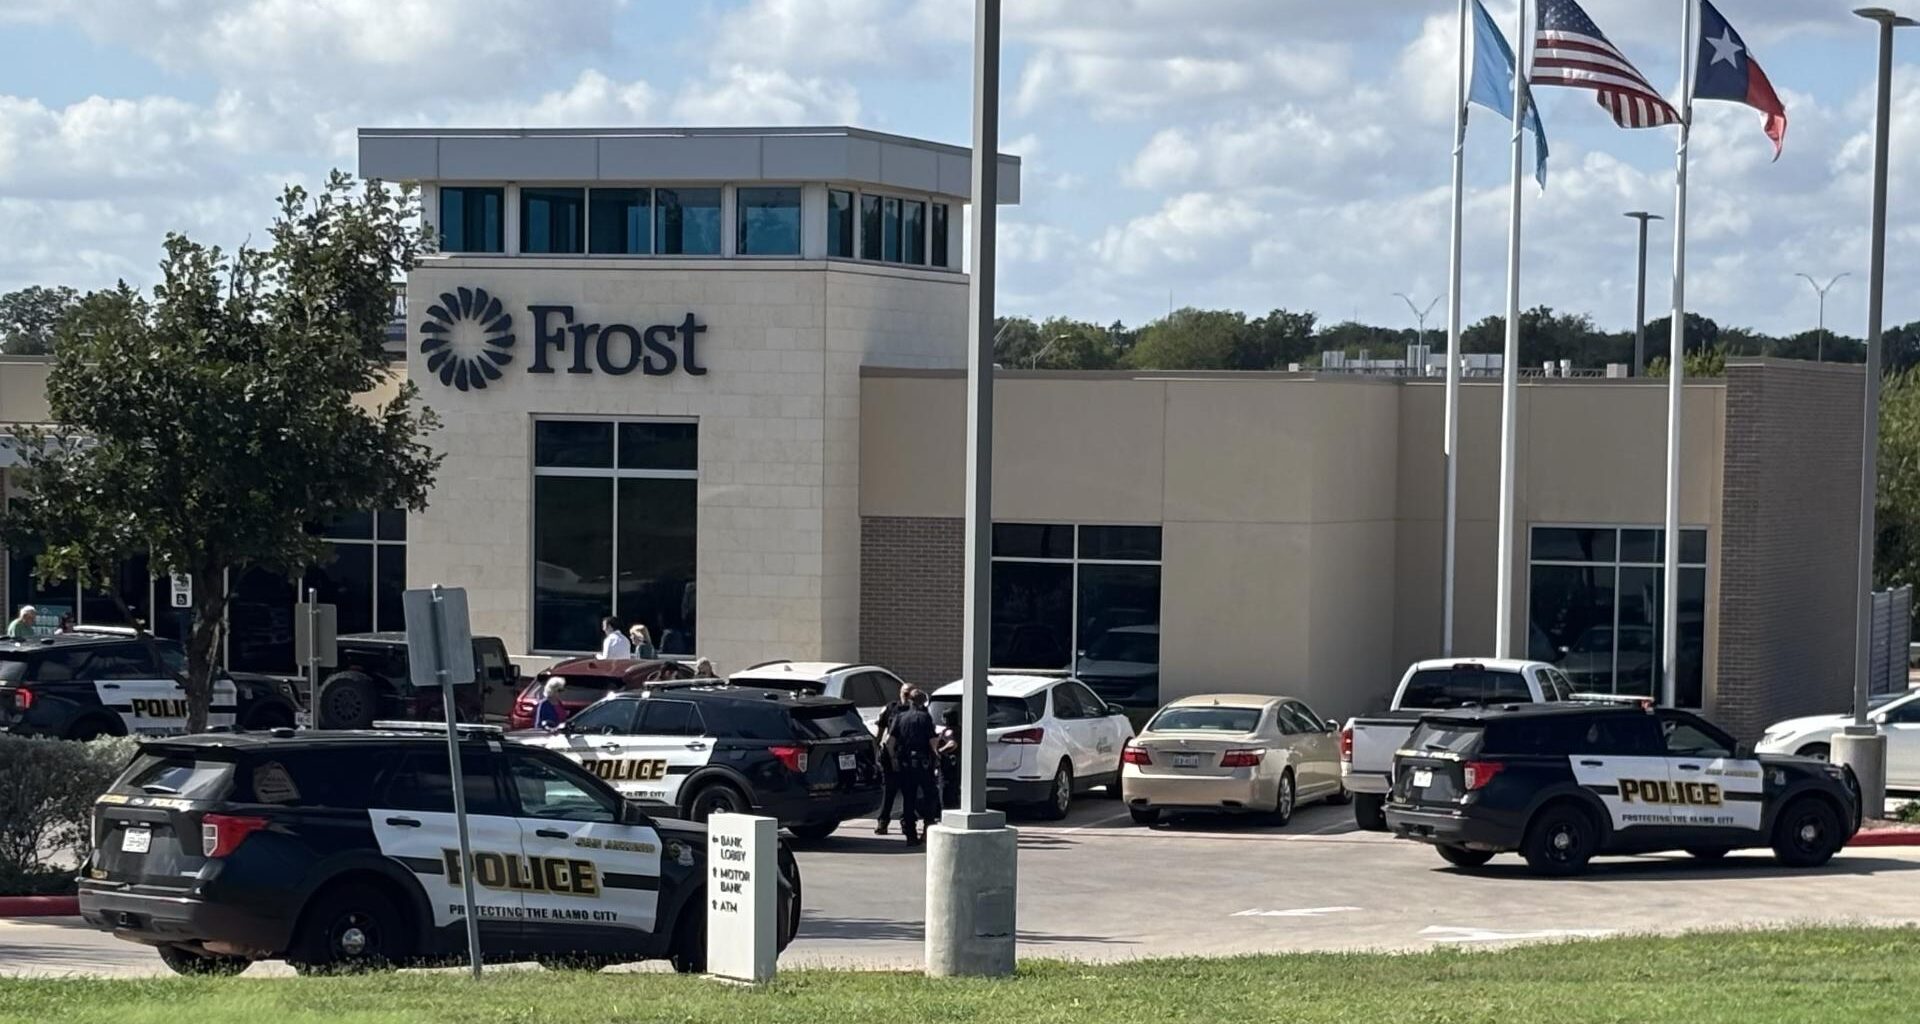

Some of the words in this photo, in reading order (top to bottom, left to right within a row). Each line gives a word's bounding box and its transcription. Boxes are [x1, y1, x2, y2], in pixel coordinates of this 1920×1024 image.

[527, 305, 708, 376] Frost
[131, 698, 188, 718] POLI
[1618, 778, 1723, 807] POLICE
[1672, 815, 1687, 823] THE
[1717, 816, 1734, 824] CITY
[720, 835, 743, 848] BANK
[720, 848, 746, 862] LOBBY
[441, 847, 601, 898] POLICE
[720, 867, 751, 882] MOTOR
[720, 881, 742, 894] BANK
[449, 904, 523, 919] PRTECTING
[526, 907, 549, 919] THE
[551, 908, 589, 920] ALAMO
[593, 910, 618, 922] CITY
[719, 900, 738, 914] ATM
